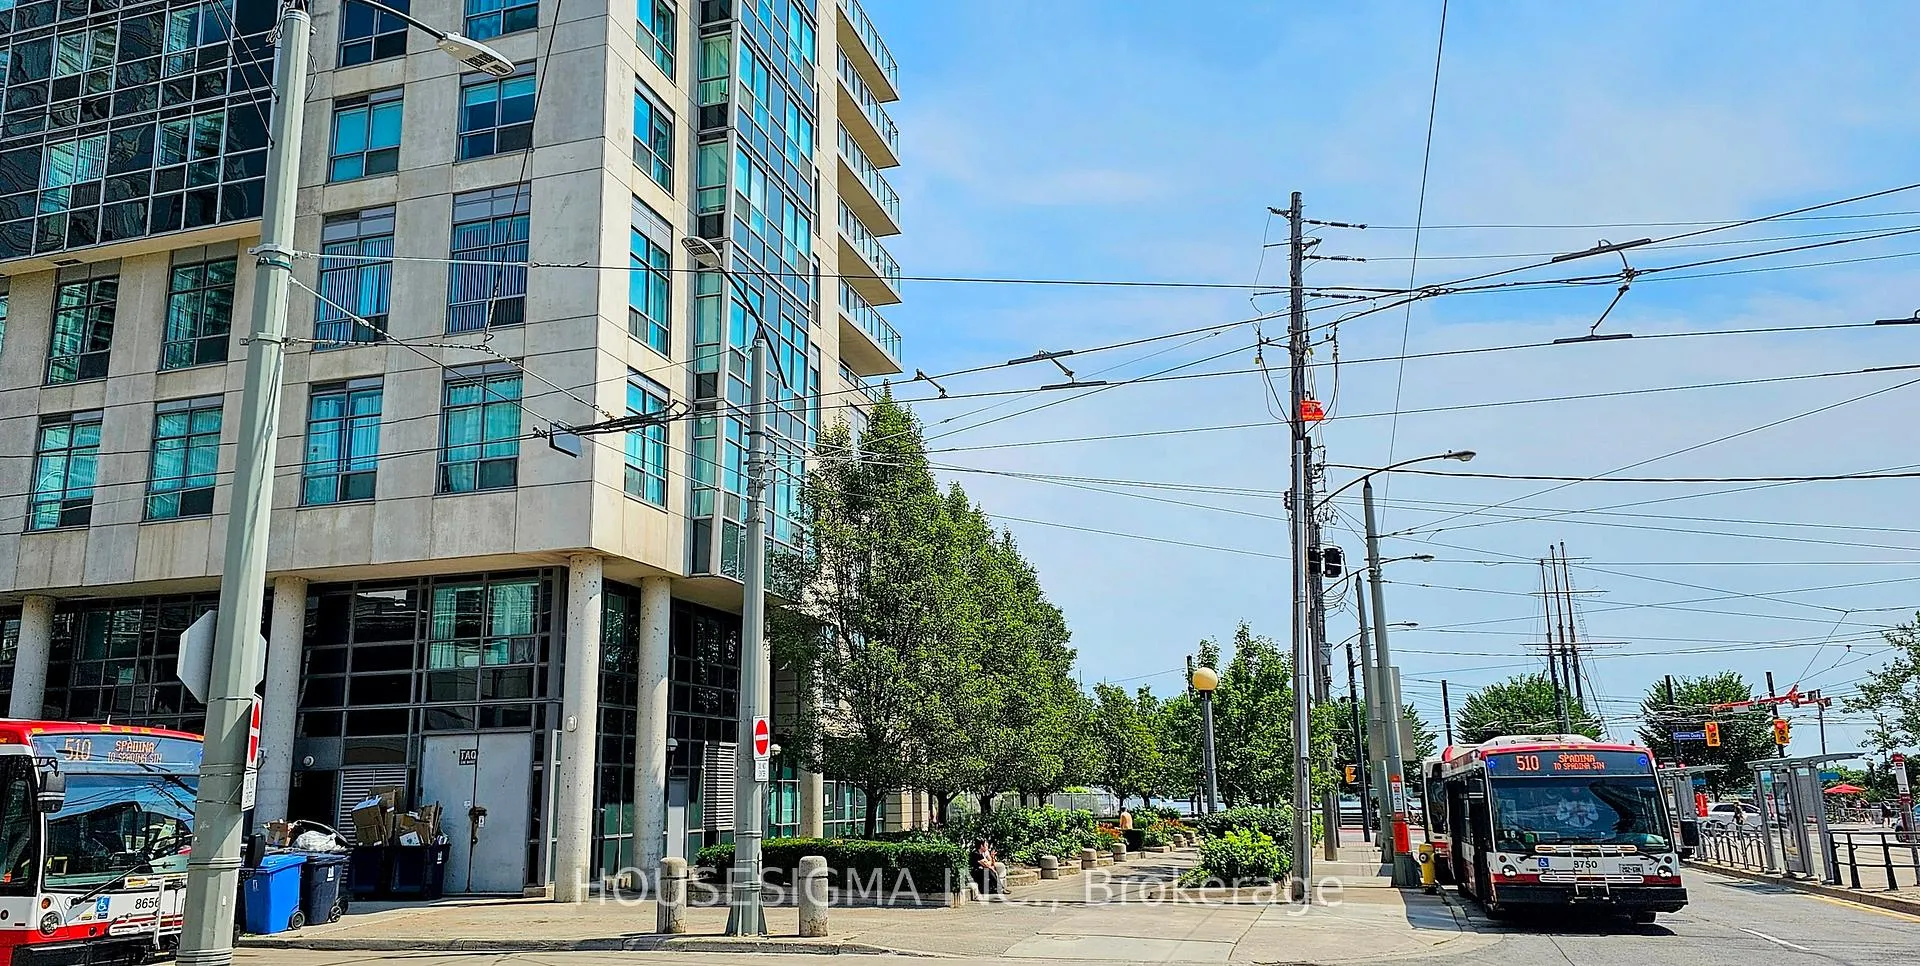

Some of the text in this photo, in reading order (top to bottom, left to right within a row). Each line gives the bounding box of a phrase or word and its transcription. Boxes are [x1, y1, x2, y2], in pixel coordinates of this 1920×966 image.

[64, 738, 91, 760] 510
[115, 740, 155, 752] SPADINA
[1516, 755, 1539, 770] 510
[1558, 754, 1596, 763] SPADINA
[1553, 762, 1605, 770] TO SPADINA STN
